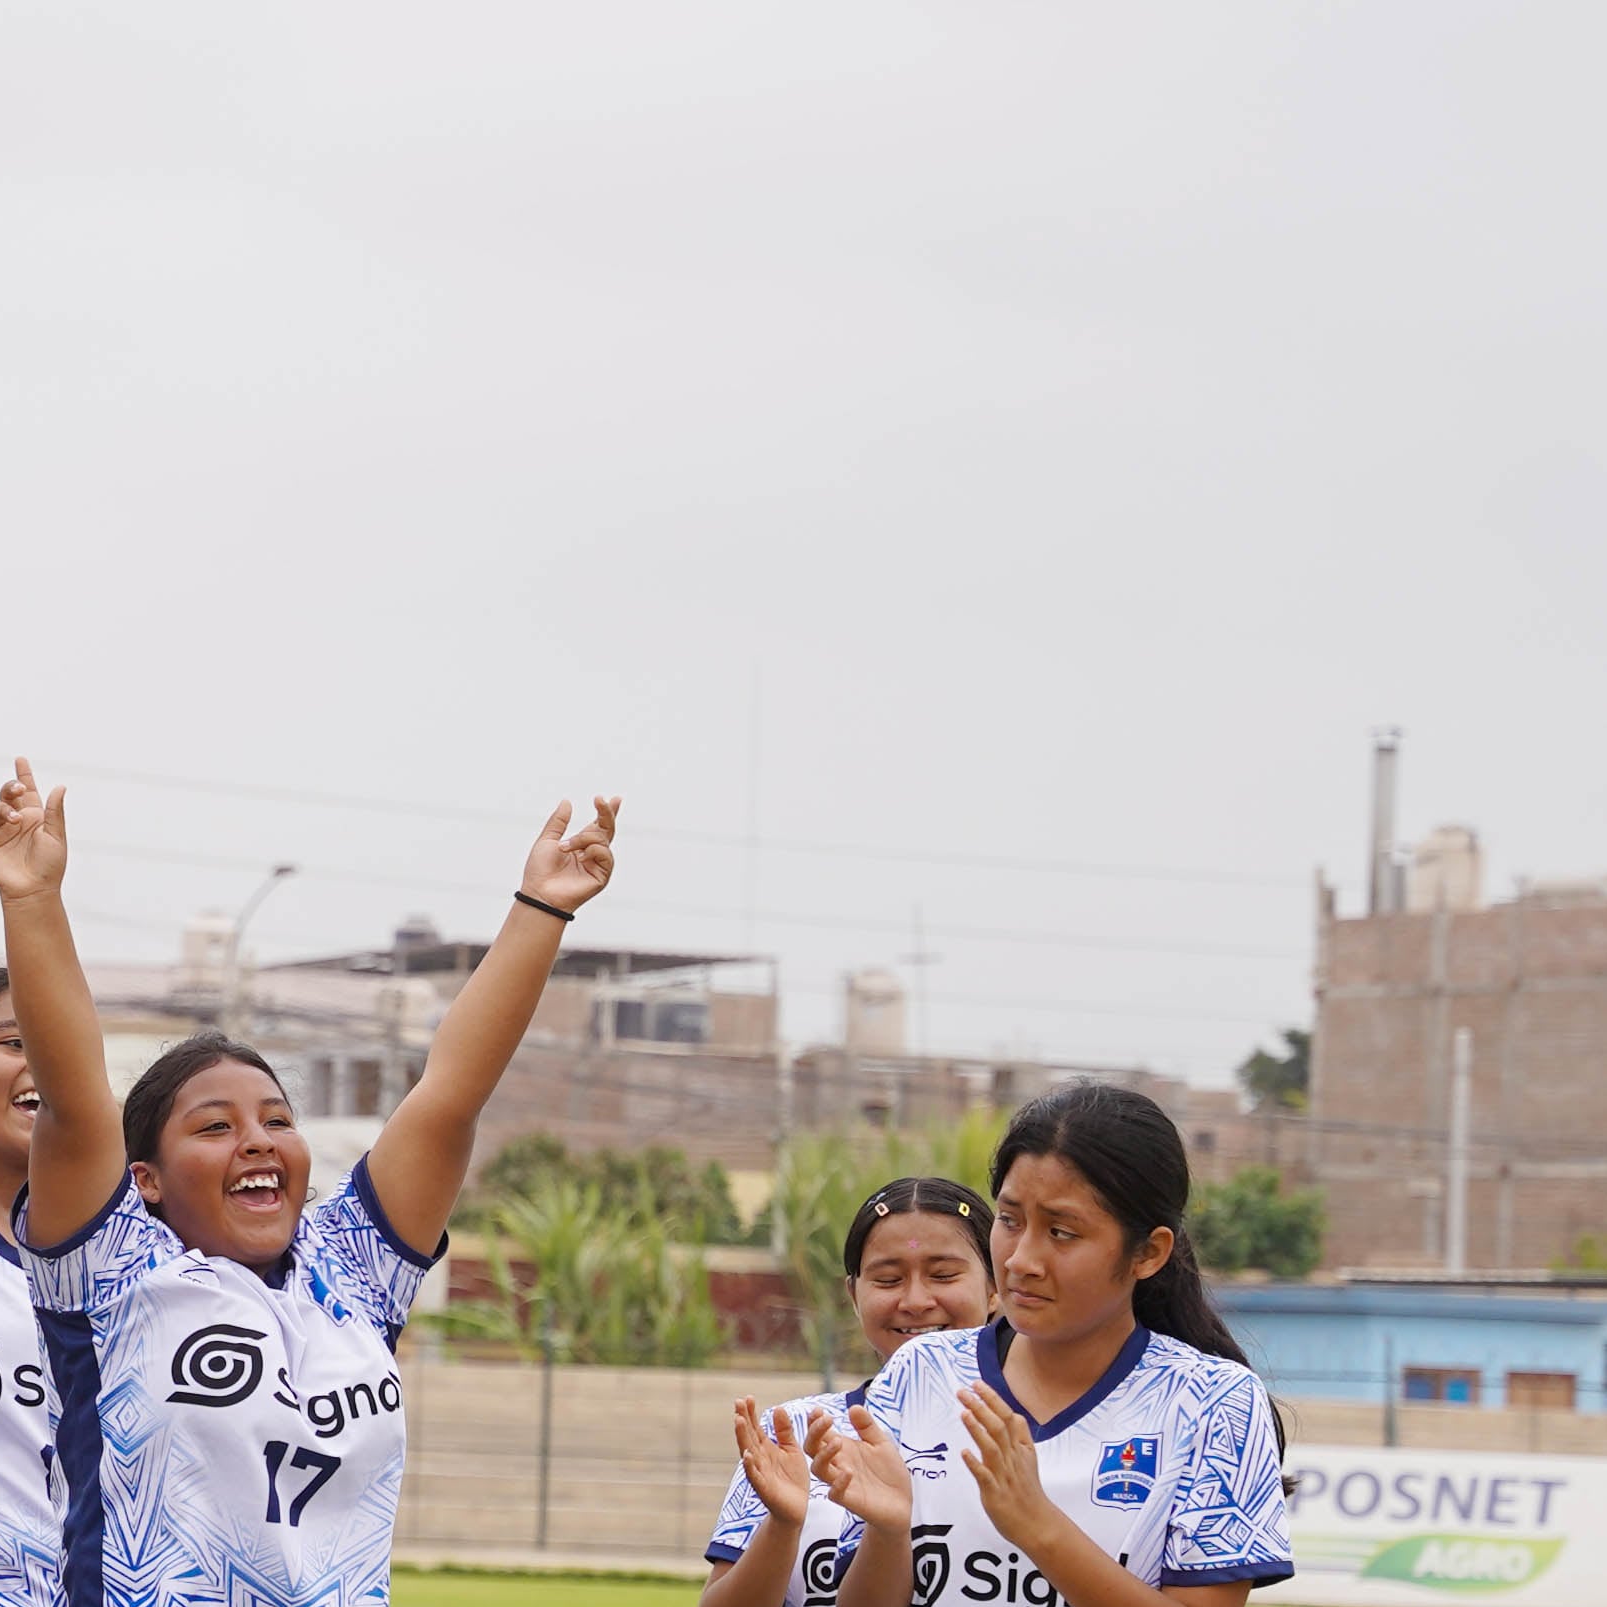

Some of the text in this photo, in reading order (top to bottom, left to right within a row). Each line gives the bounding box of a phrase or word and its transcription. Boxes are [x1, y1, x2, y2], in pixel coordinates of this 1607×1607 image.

[274, 1367, 403, 1438] Sgna
[1141, 1442, 1154, 1456] E
[263, 1440, 342, 1527] 17
[1289, 1467, 1569, 1527] POSNET
[1412, 1541, 1535, 1584] AGRO
